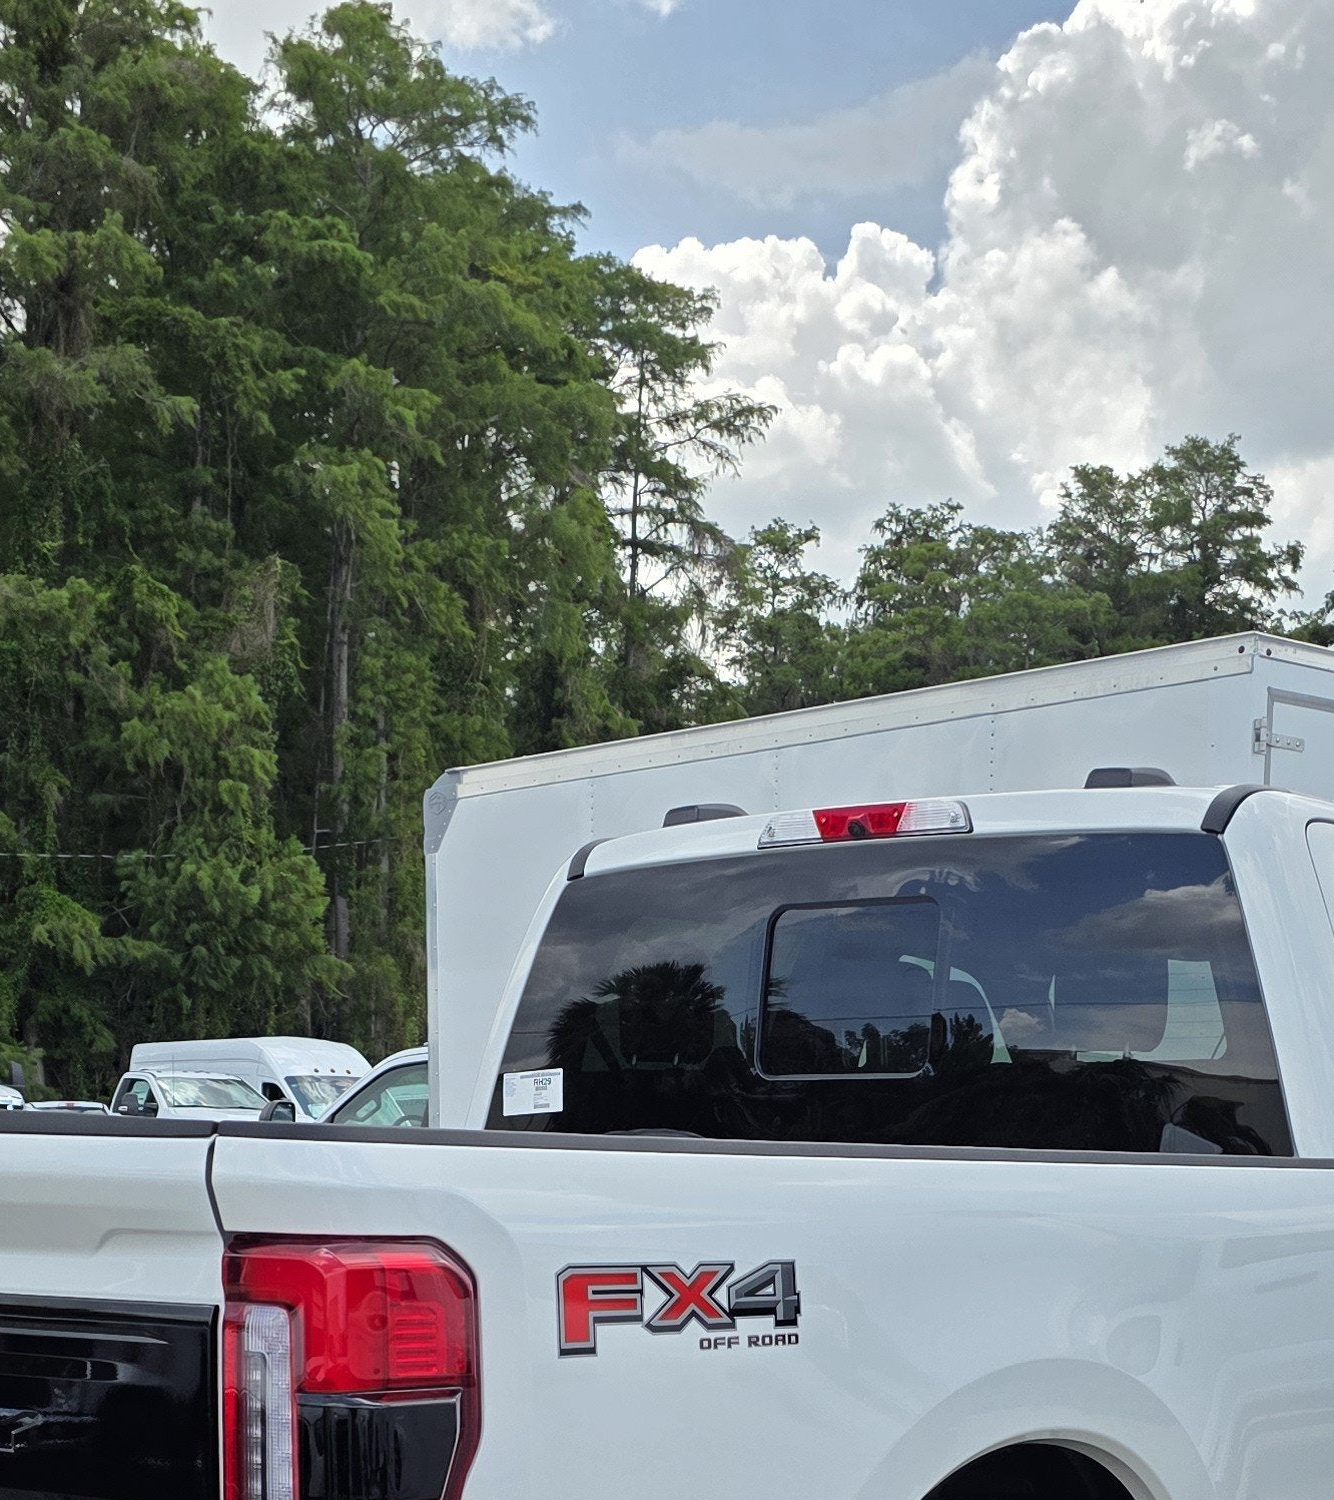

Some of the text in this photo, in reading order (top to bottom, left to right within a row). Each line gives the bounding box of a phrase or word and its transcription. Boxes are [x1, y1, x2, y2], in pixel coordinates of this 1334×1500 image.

[555, 1260, 801, 1359] FX4
[699, 1332, 799, 1350] OFF ROAD
